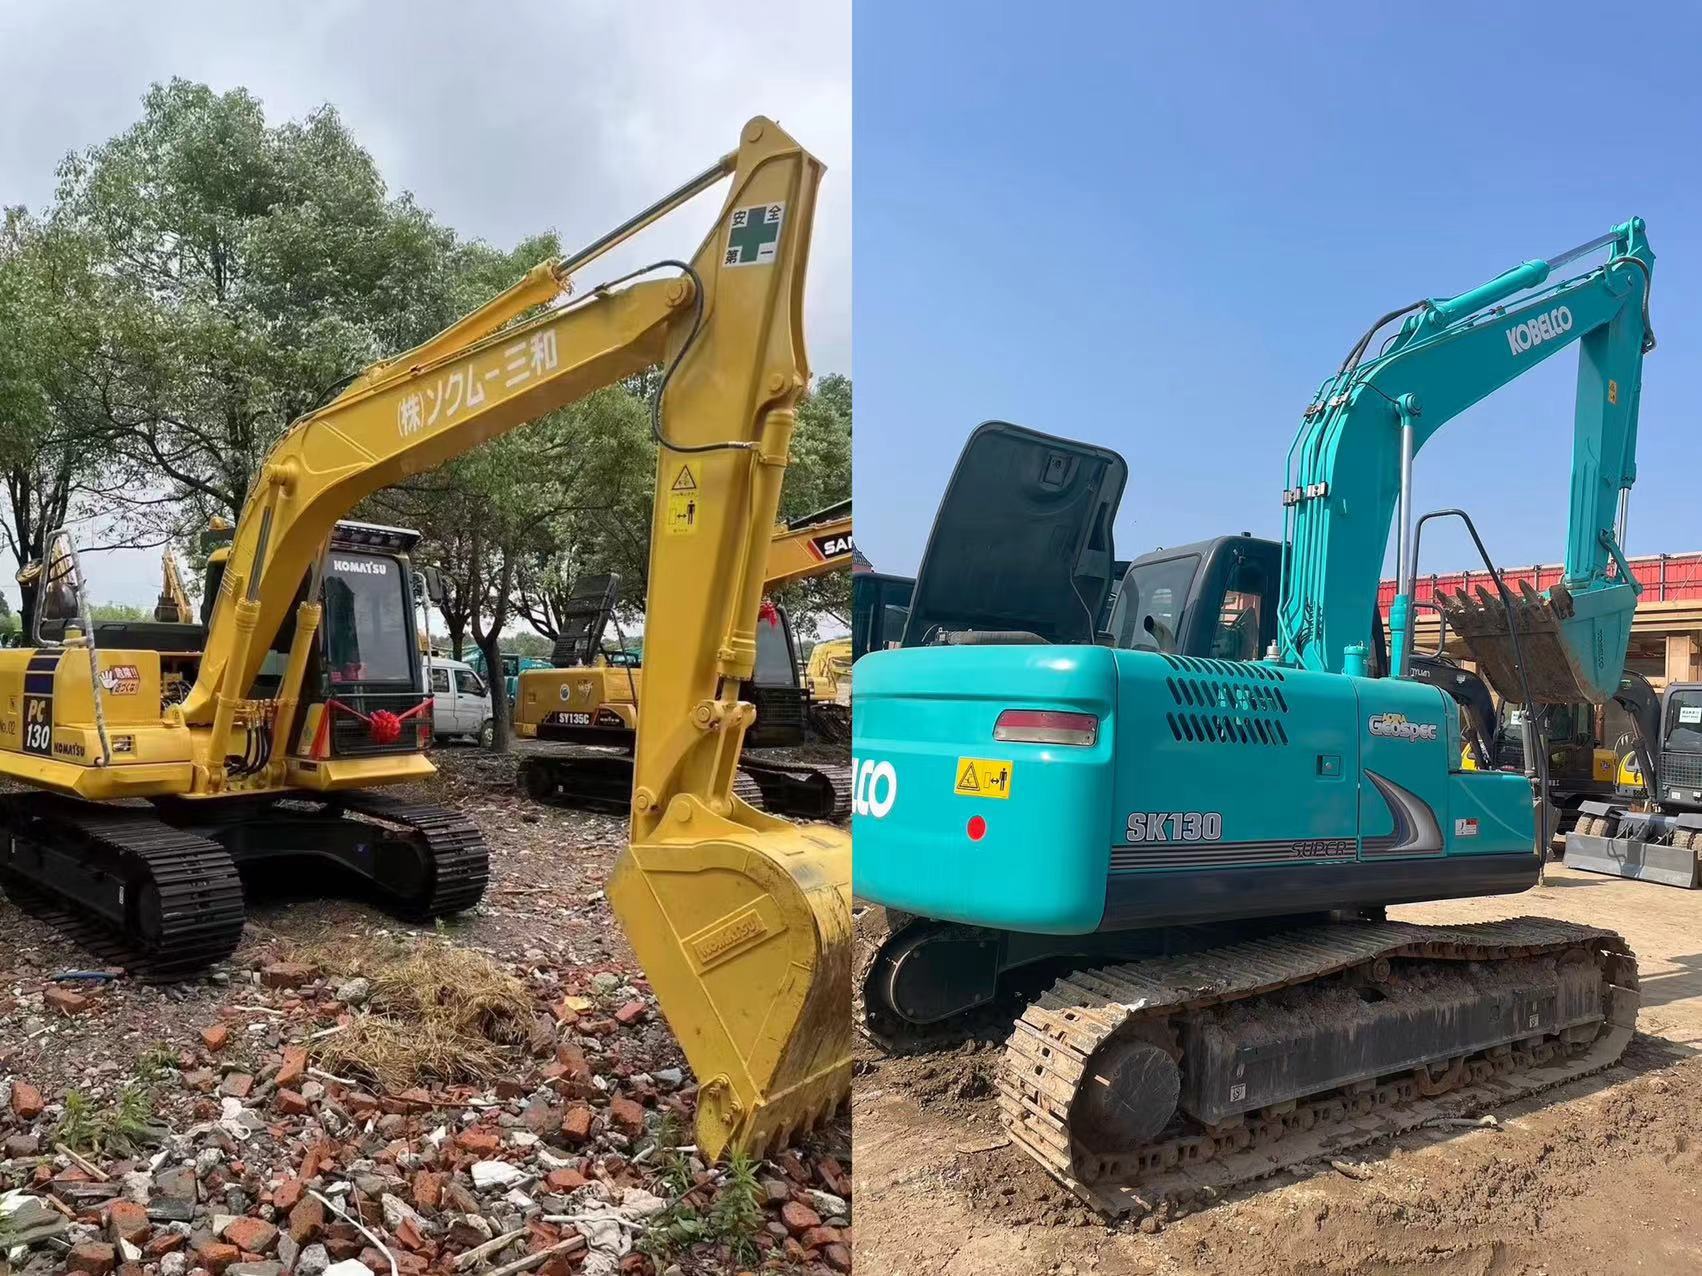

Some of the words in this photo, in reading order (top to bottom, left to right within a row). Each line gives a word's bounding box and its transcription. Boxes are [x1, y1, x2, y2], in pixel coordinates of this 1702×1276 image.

[732, 205, 782, 226] 安全
[725, 249, 773, 264] 第一
[1505, 305, 1572, 356] KOBELCO
[333, 559, 386, 575] KOMATSU
[27, 699, 46, 723] PC
[559, 712, 590, 725] SY135C
[26, 723, 50, 750] 130
[54, 742, 85, 757] KOMATSU
[1126, 811, 1222, 842] SK130
[1291, 840, 1347, 858] SUPER
